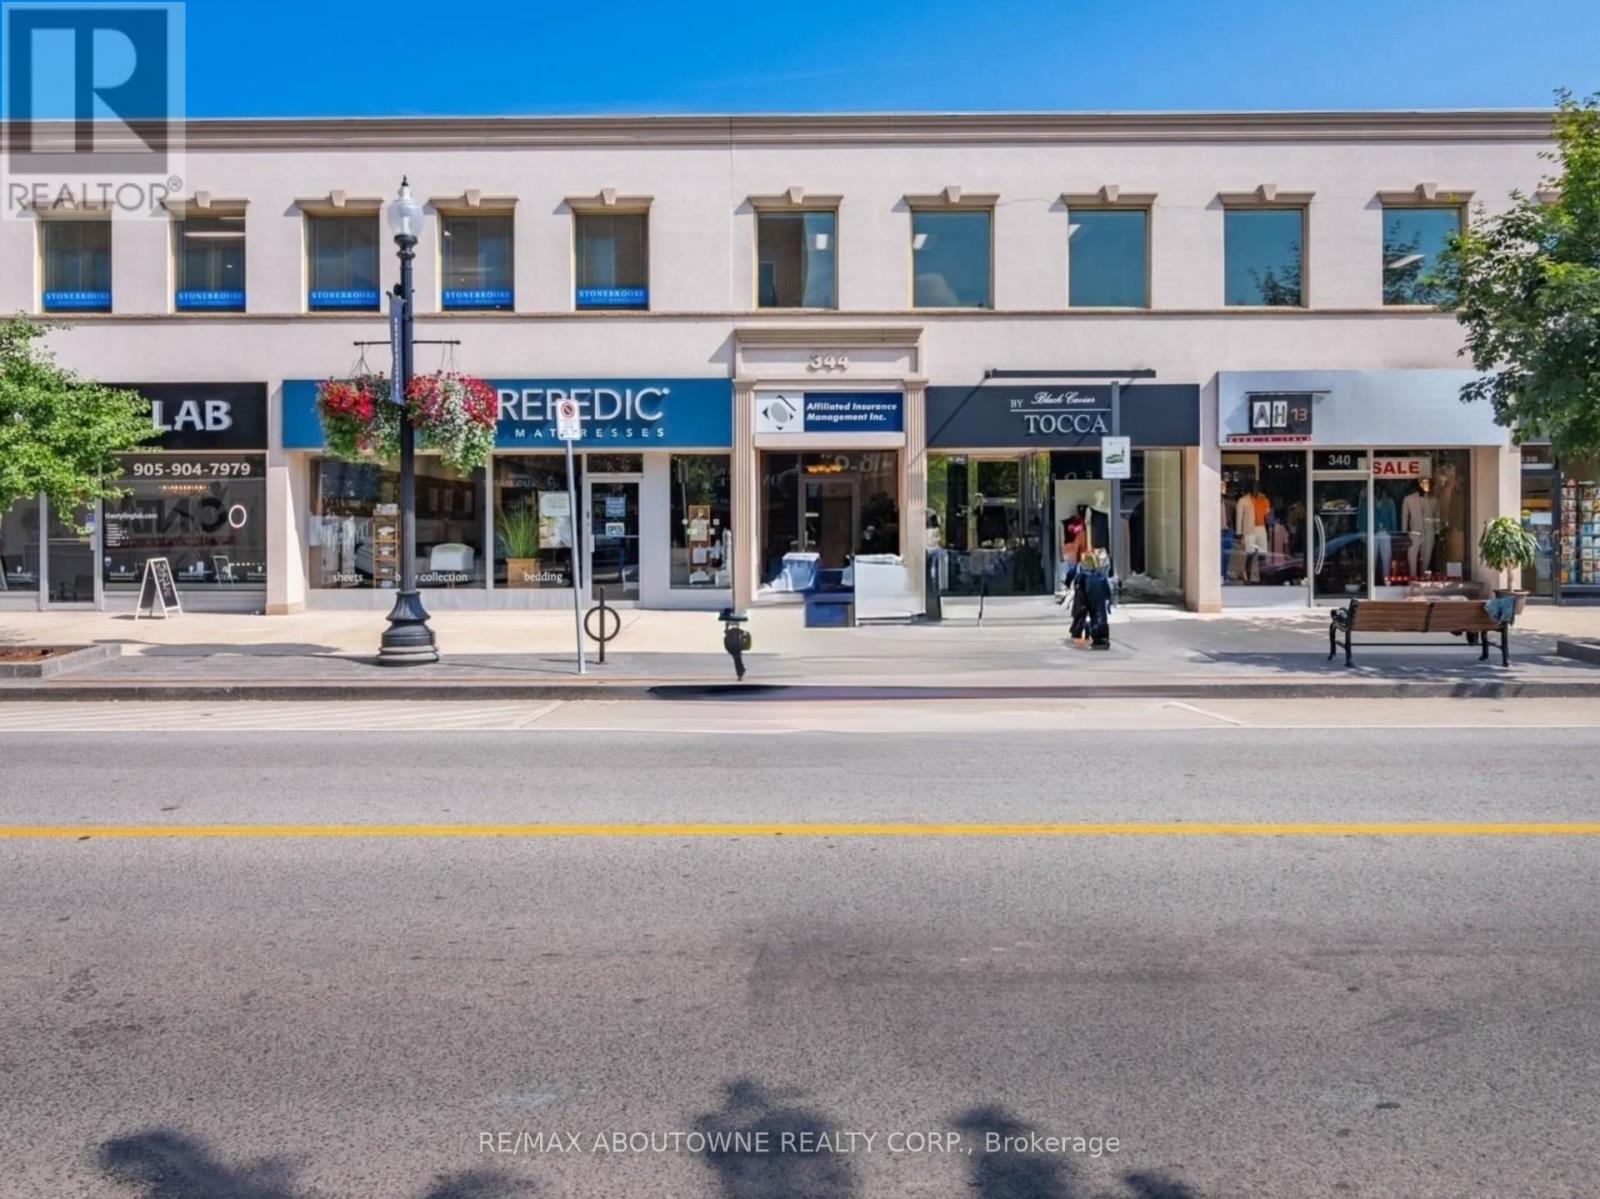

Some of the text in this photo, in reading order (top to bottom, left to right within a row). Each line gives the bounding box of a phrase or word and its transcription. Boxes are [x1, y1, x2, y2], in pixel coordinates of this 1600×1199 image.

[808, 353, 849, 372] 344
[1010, 391, 1096, 408] BY Black Caviar
[806, 402, 897, 411] Affiliated Insurance
[152, 399, 232, 432] LAB
[806, 412, 887, 423] Management Inc.
[1024, 415, 1108, 433] TOCCA
[514, 428, 665, 438] MATRESSES
[1328, 455, 1351, 466] 340
[133, 463, 251, 476] 905-904-7979
[1372, 461, 1420, 475] SALE
[332, 573, 363, 582] sheets
[420, 572, 468, 582] collection
[524, 571, 563, 583] bedding
